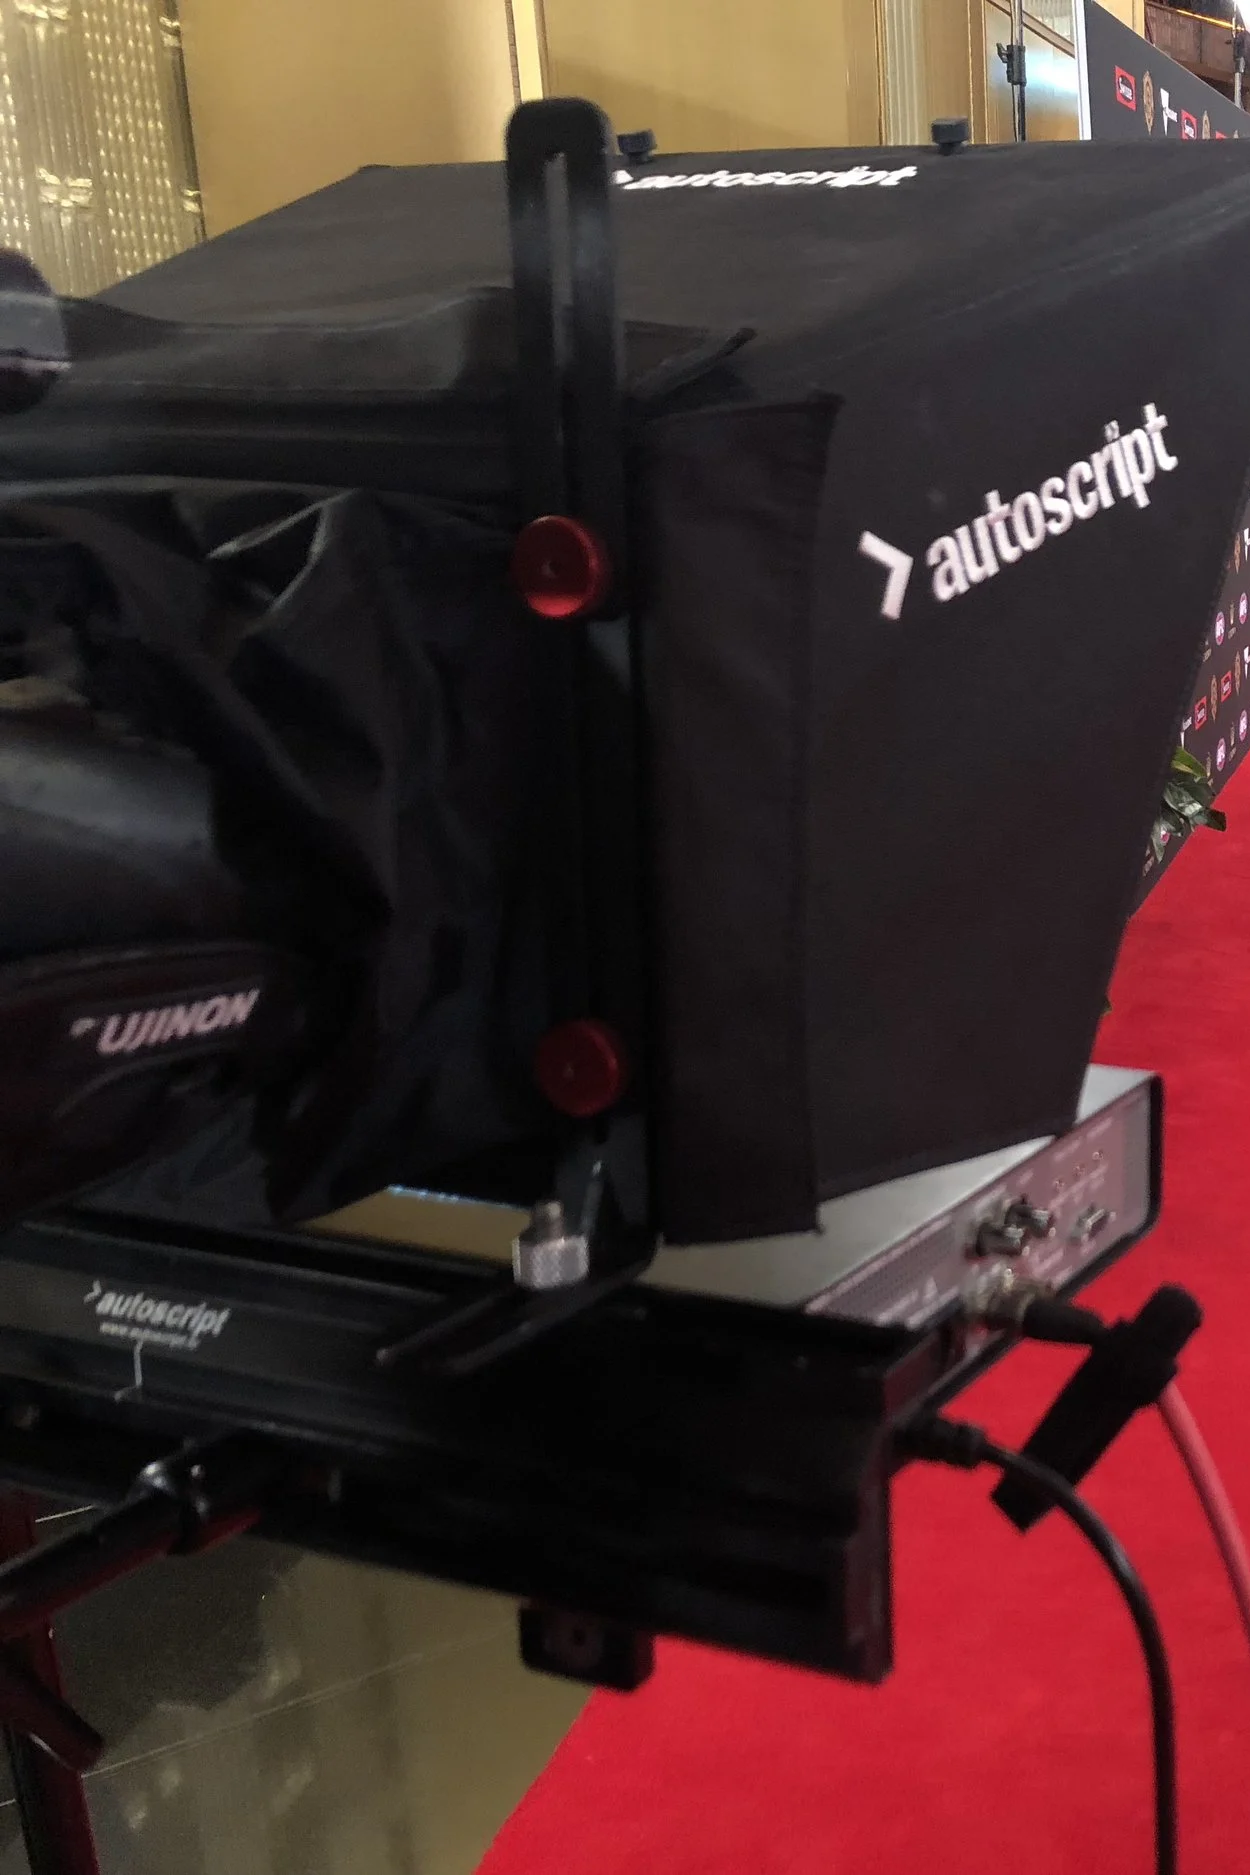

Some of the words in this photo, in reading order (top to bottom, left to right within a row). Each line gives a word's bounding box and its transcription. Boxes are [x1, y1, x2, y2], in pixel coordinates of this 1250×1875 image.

[624, 165, 918, 190] autoscript
[926, 402, 1178, 602] autoscript
[96, 1292, 231, 1338] autoscript
